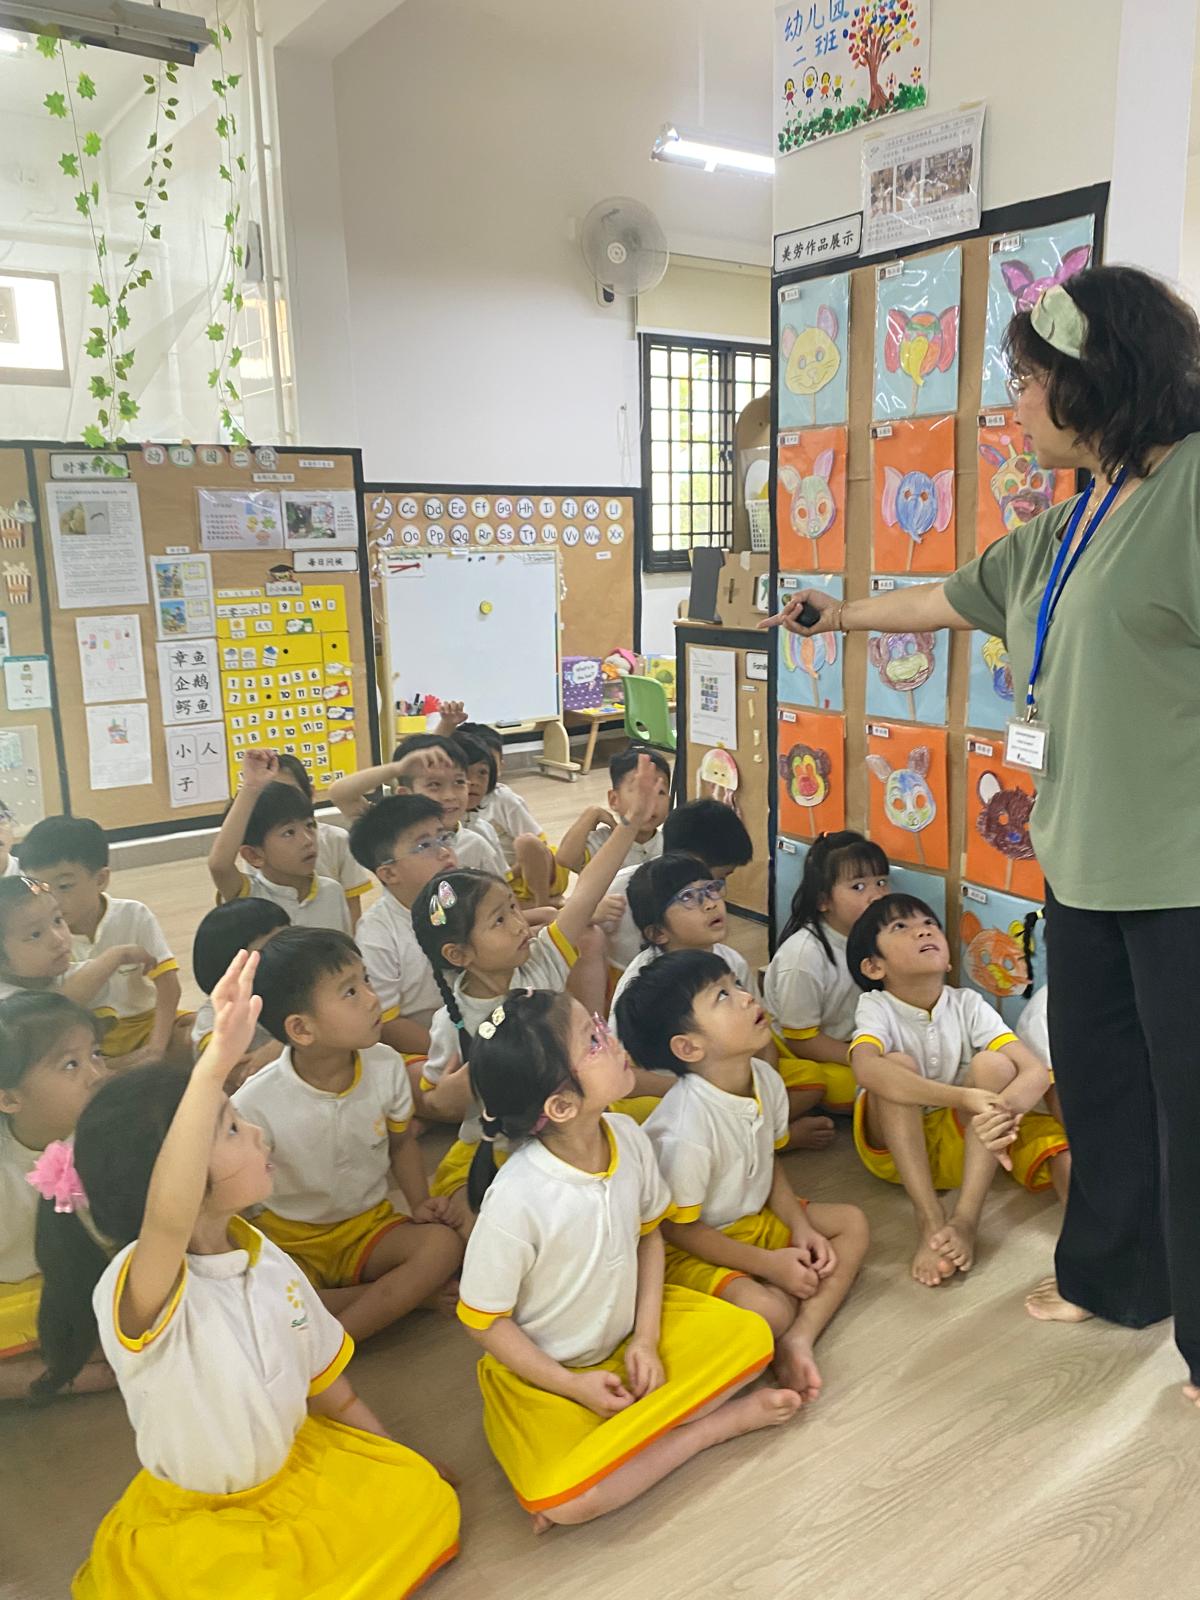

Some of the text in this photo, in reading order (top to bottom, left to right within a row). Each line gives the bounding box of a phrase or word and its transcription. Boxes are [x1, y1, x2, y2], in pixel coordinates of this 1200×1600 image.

[785, 0, 846, 41] 幼儿园
[793, 28, 839, 66] 二班
[781, 229, 854, 263] 美劳作品展示
[282, 602, 287, 610] 9
[312, 600, 320, 609] 14
[171, 649, 207, 667] 章鱼
[175, 673, 209, 691] 企鹅
[176, 699, 211, 715] 鳄鱼
[176, 742, 218, 758] 小 人
[177, 776, 195, 792] 子
